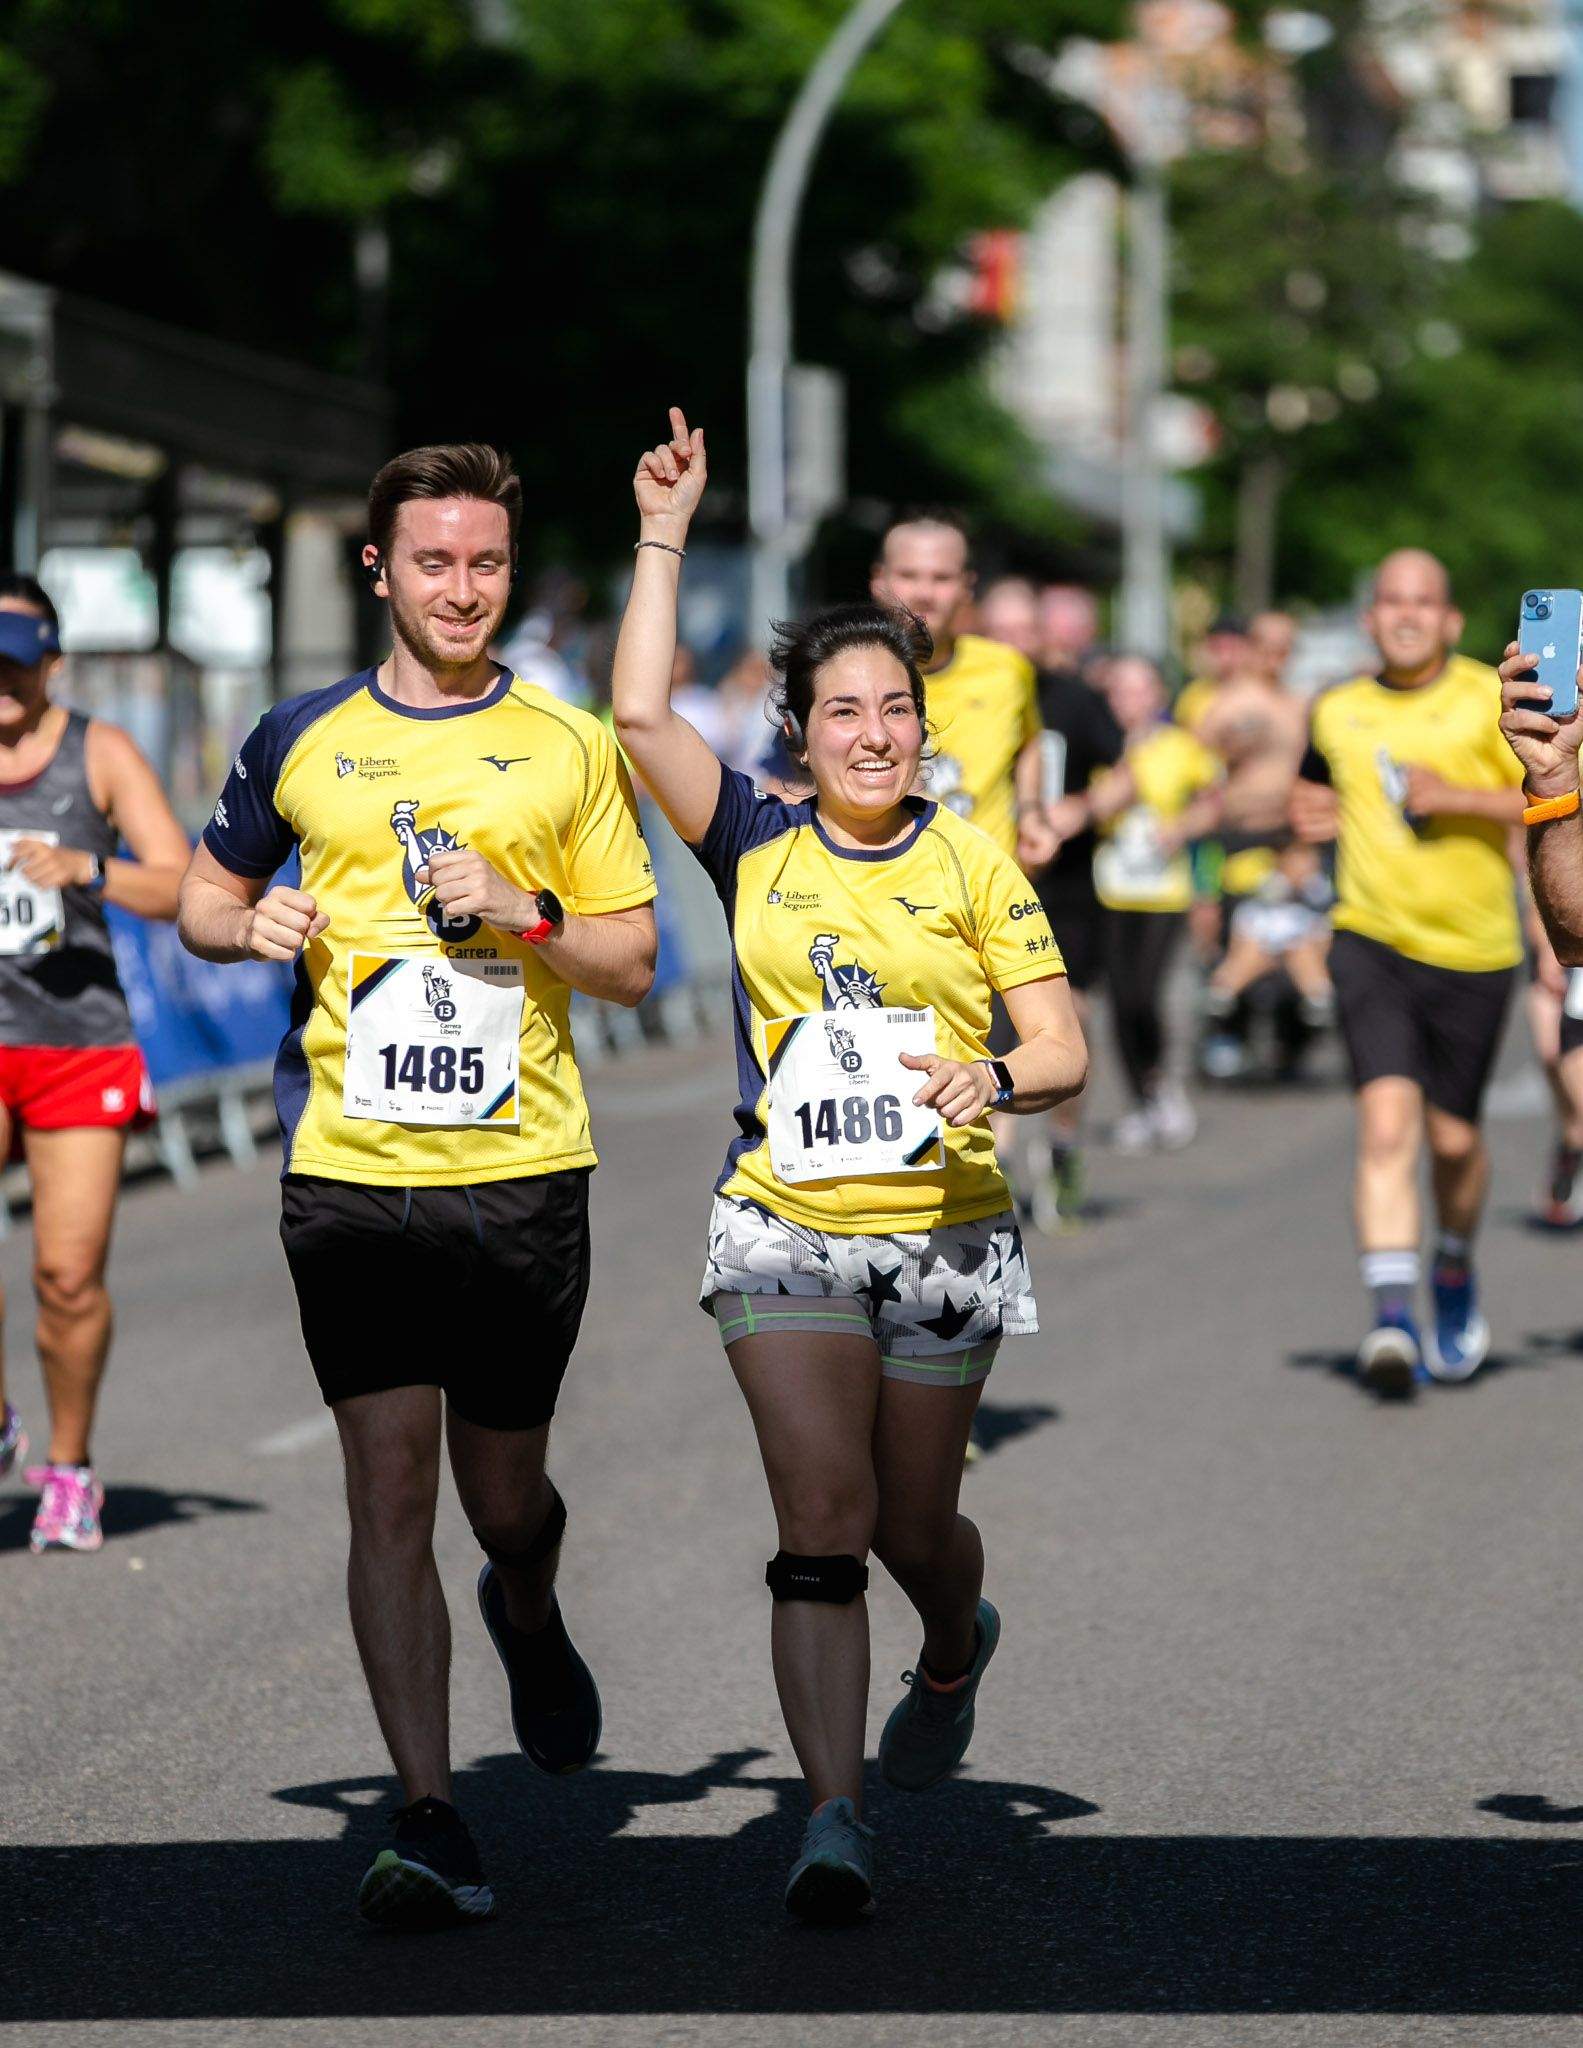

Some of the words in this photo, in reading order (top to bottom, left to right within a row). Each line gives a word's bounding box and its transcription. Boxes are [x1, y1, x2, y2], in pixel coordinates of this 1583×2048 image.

[359, 756, 397, 768] Liberty
[445, 946, 498, 959] Carrera
[438, 1003, 452, 1018] 13
[844, 1055, 859, 1068] 13
[378, 1043, 484, 1095] 1485
[794, 1093, 903, 1150] 1486
